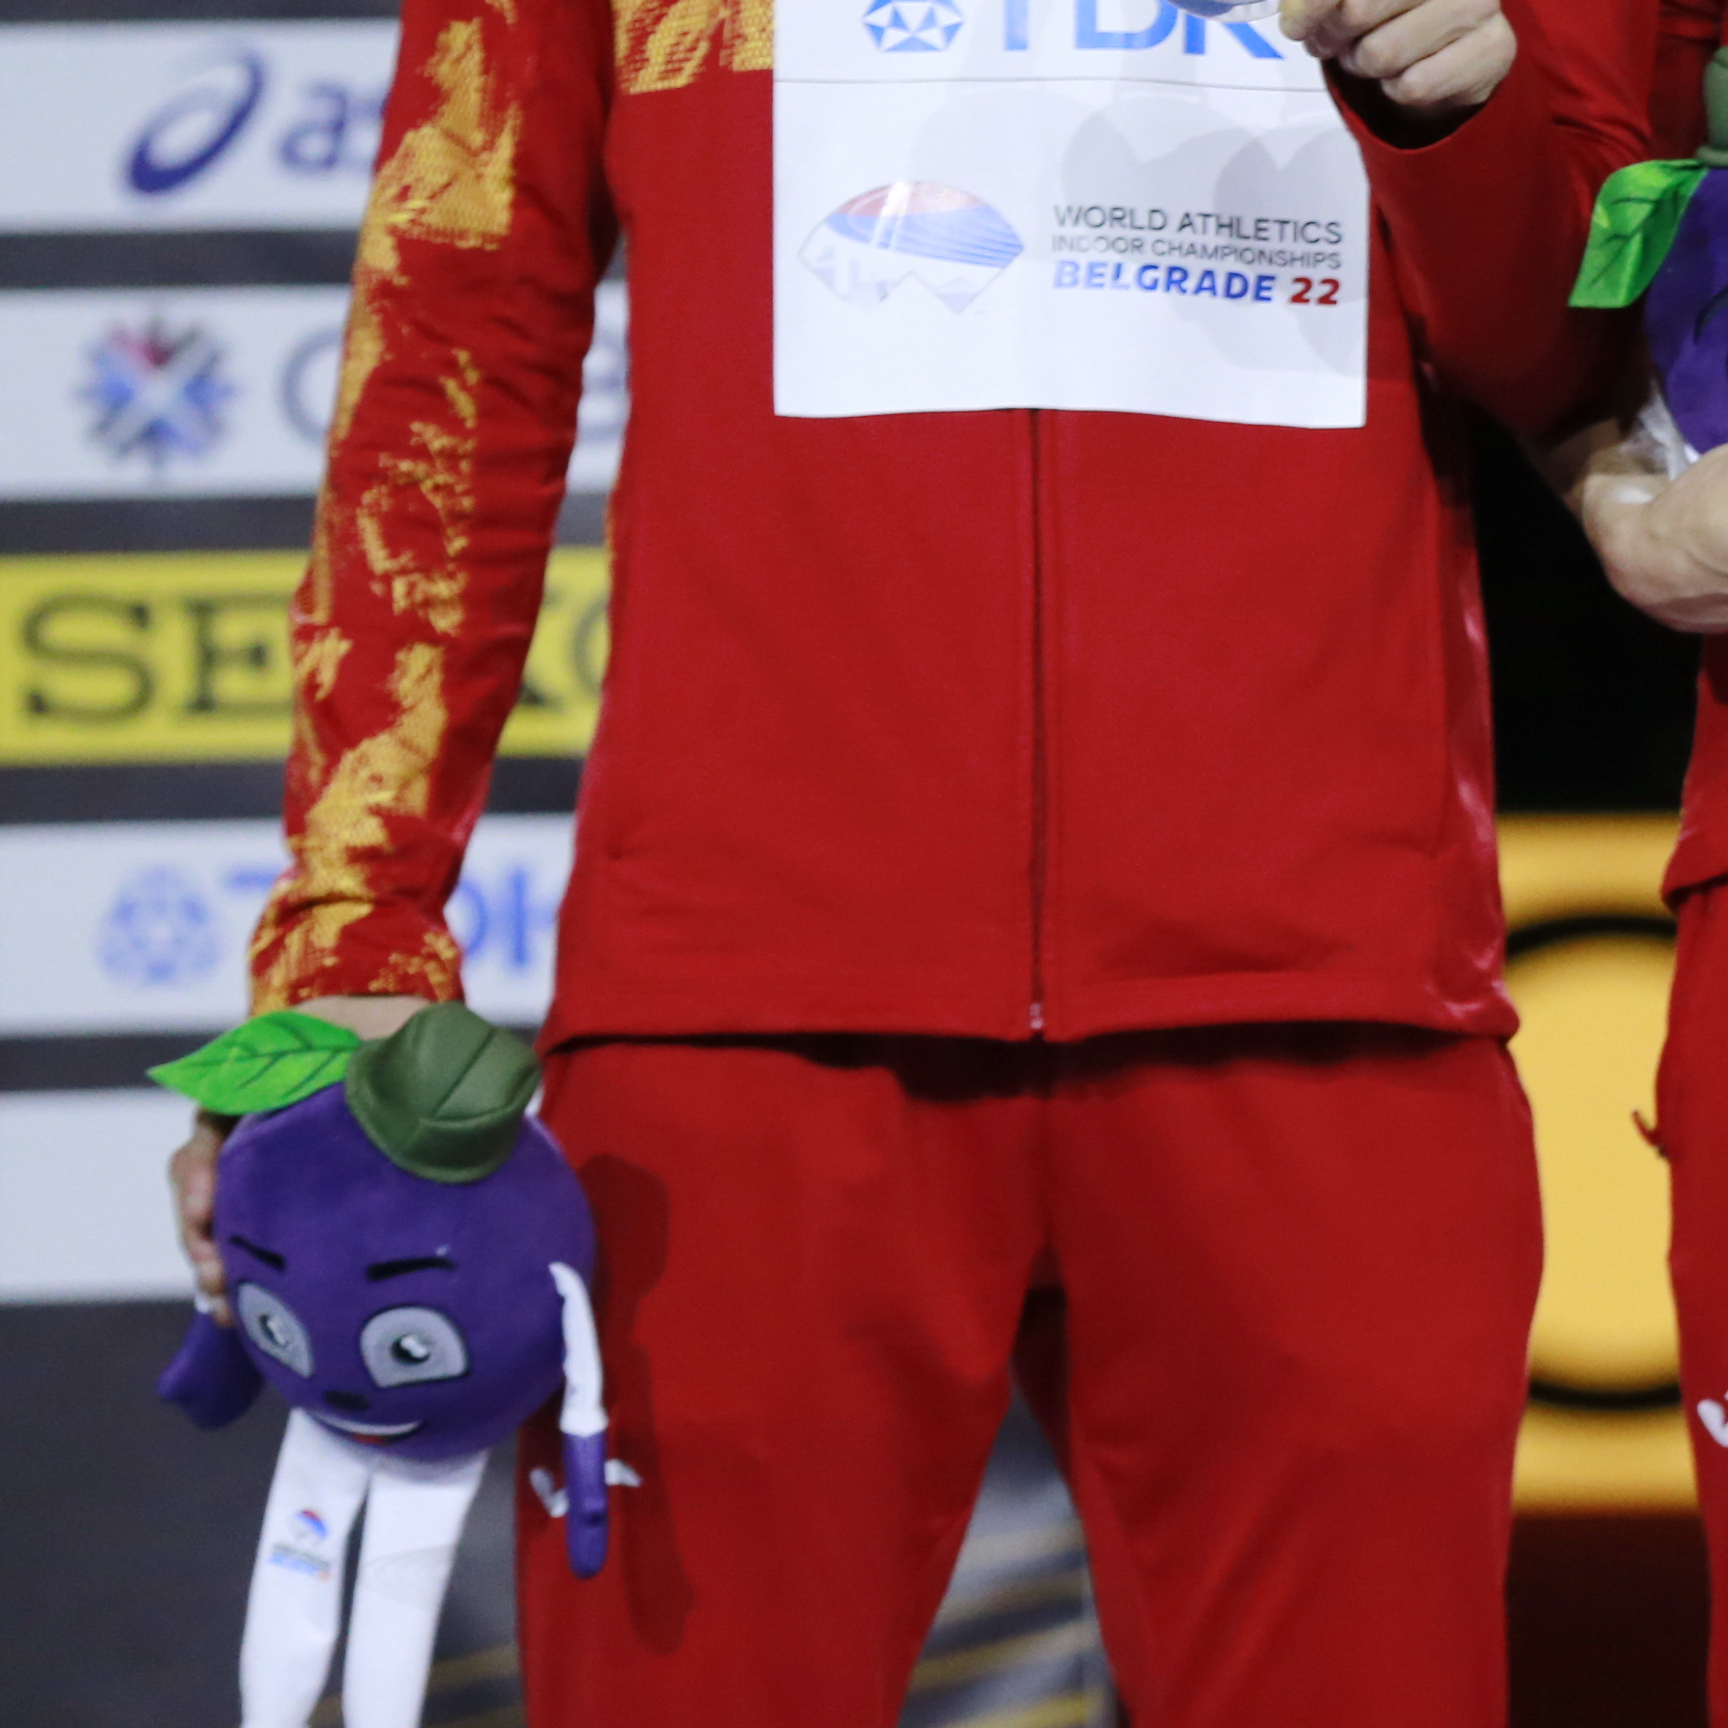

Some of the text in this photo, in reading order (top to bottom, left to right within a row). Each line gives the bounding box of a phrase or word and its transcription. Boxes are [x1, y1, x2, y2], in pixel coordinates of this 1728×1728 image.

[1053, 204, 1343, 245] WORLD ATHLETICS
[1052, 234, 1342, 270] INDOOR CHAMPIONSHIPS
[1054, 260, 1341, 306] BELGRADE 22
